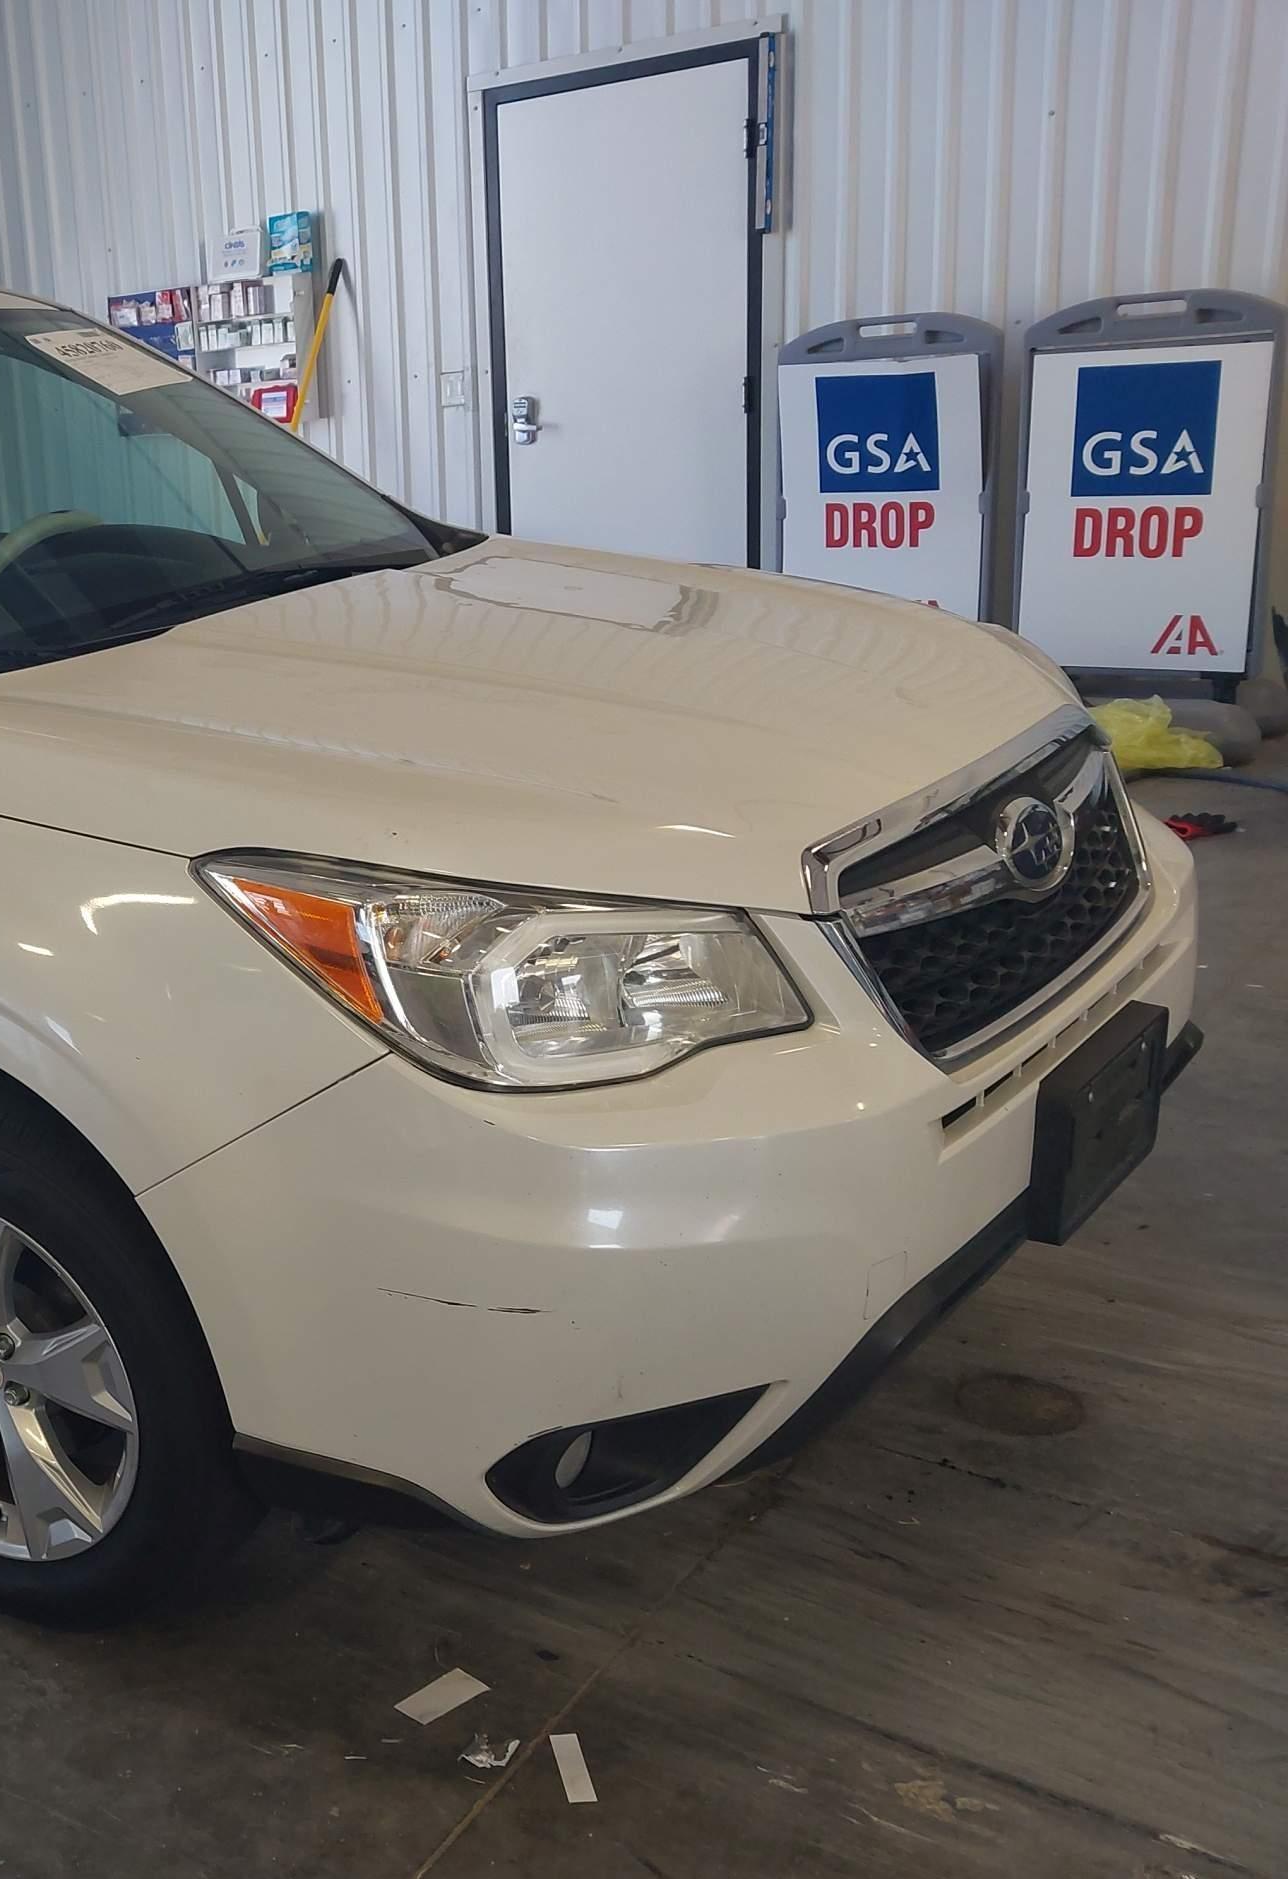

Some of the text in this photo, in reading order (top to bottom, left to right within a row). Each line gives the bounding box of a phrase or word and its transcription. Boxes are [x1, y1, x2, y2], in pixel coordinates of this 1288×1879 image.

[826, 432, 932, 474] GSA
[1082, 429, 1205, 476] GSA
[825, 501, 935, 548] DROP
[1072, 506, 1204, 558] DROP
